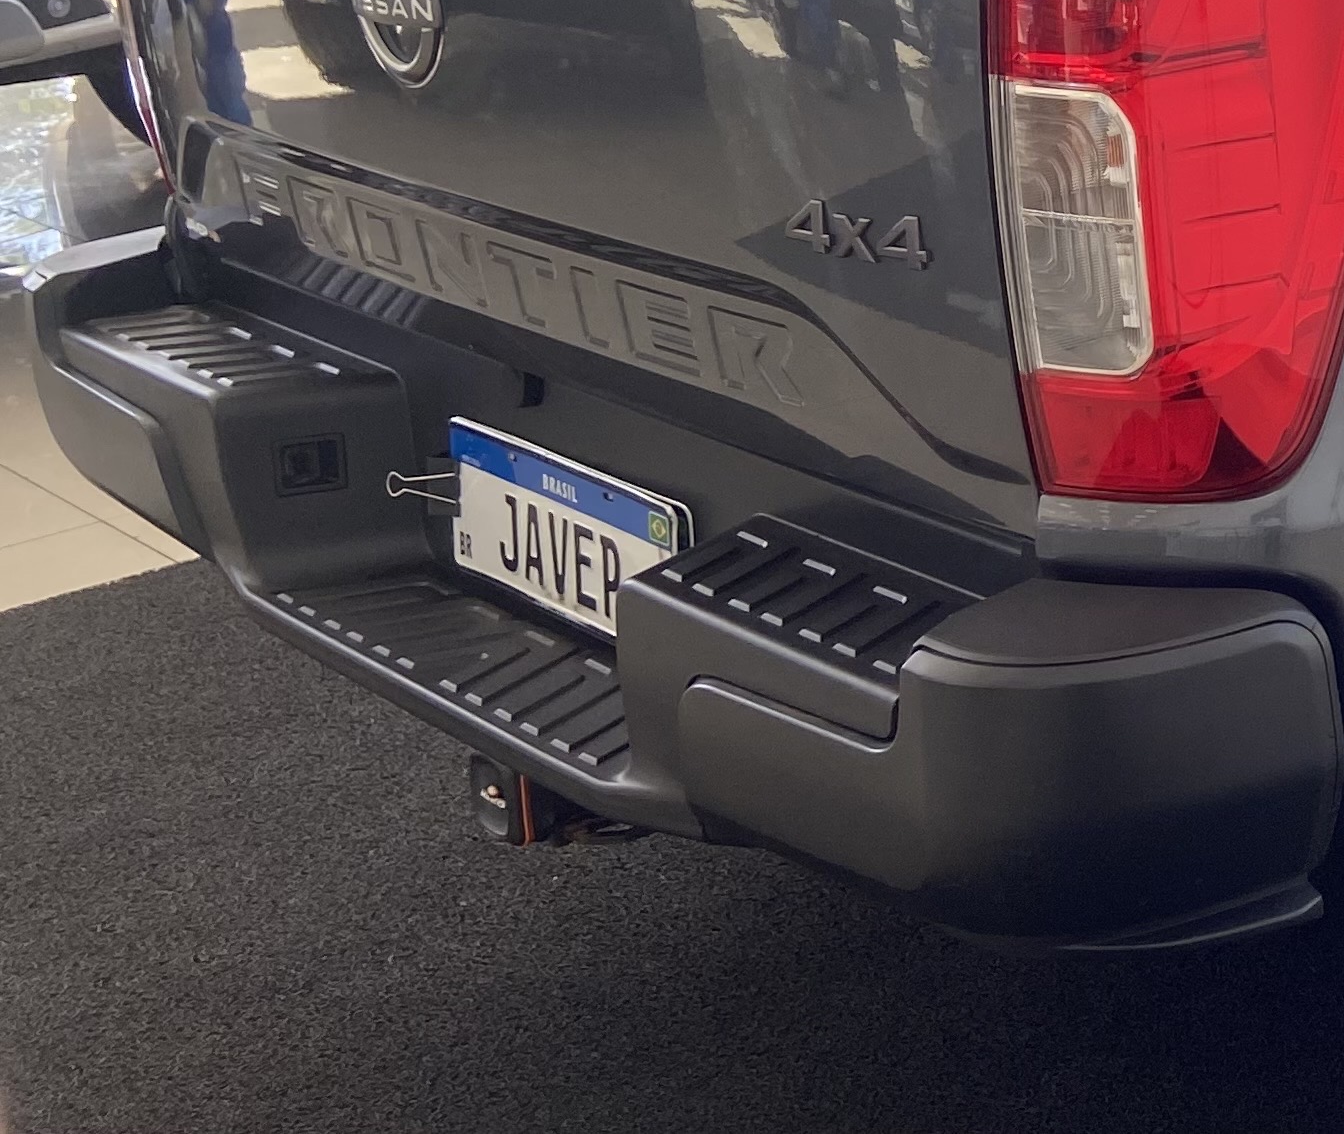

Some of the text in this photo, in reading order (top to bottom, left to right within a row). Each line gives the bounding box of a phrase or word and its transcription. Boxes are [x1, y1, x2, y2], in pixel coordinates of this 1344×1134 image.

[784, 199, 935, 271] 4x4
[542, 473, 578, 504] BRASIL
[460, 531, 473, 559] BR
[499, 493, 621, 619] JAVEP
